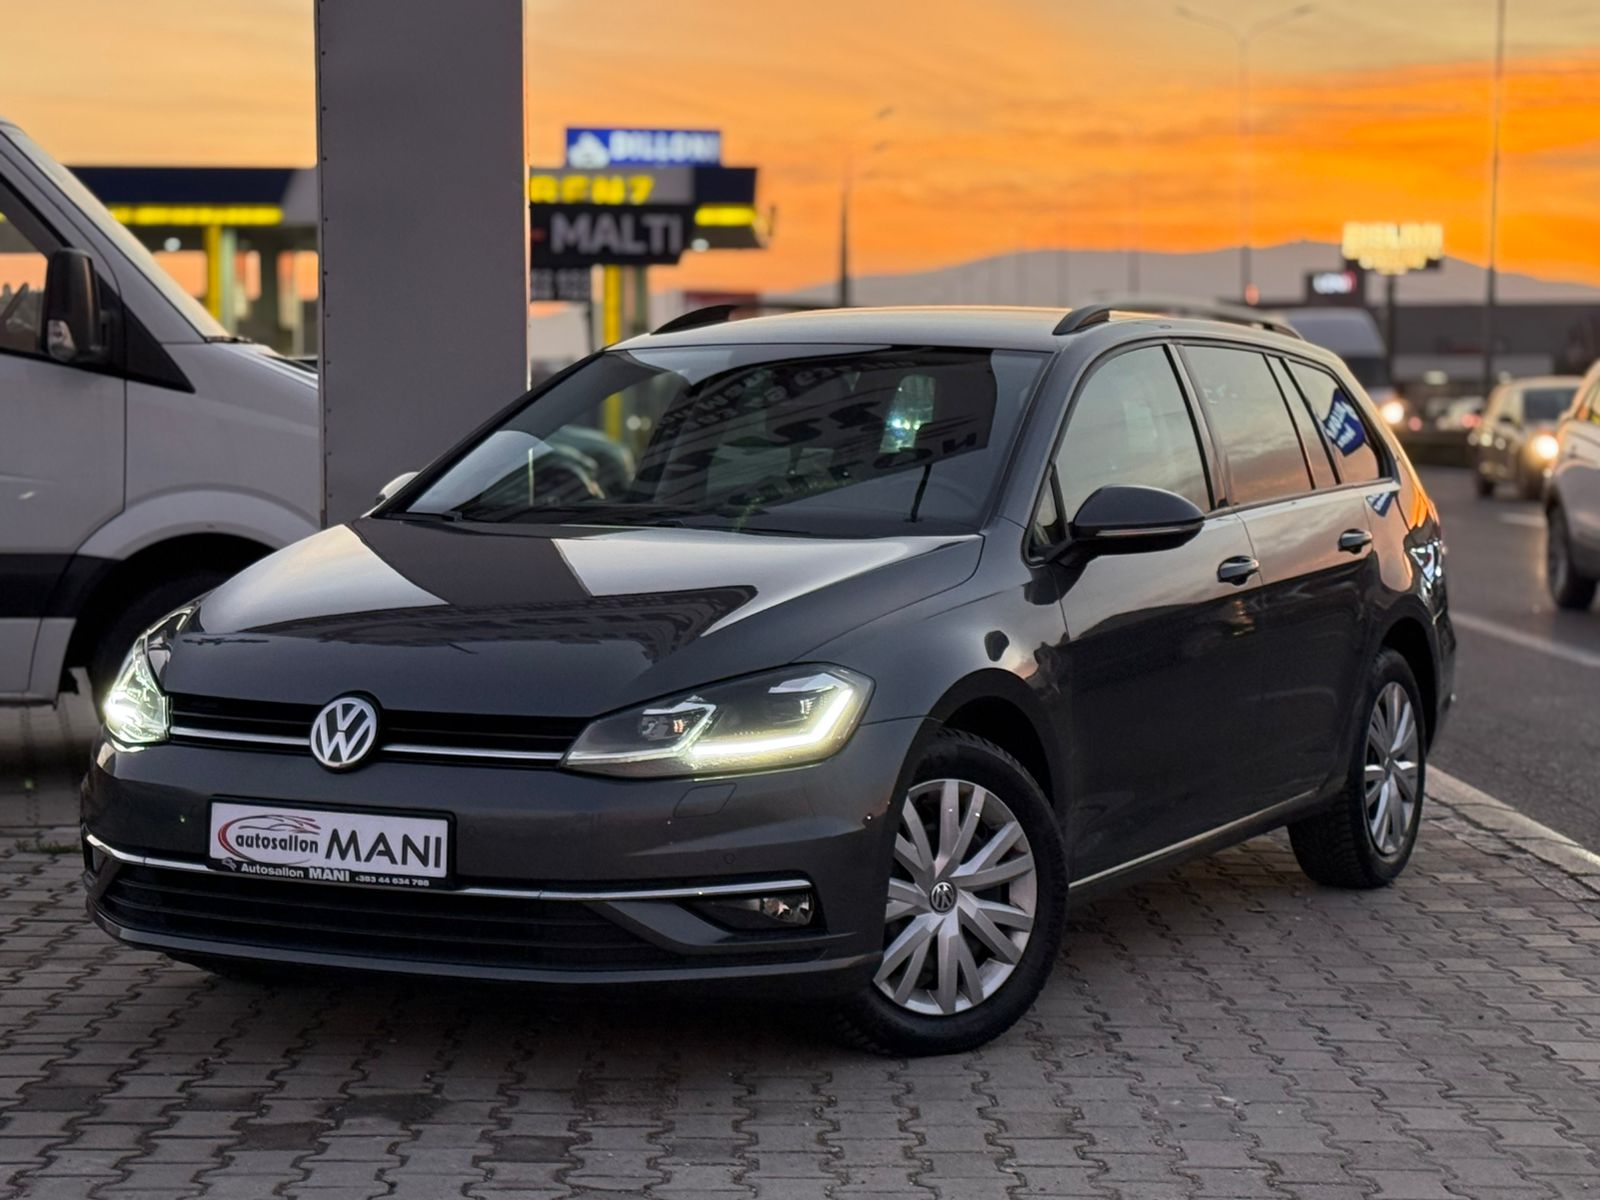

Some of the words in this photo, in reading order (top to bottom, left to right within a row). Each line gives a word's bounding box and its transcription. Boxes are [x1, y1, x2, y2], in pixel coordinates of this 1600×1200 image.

[550, 212, 683, 255] MALTI
[314, 699, 374, 765] VW
[235, 833, 319, 854] autosallon
[325, 828, 443, 868] MANI
[241, 863, 304, 879] Autosallon
[308, 867, 351, 882] MANI
